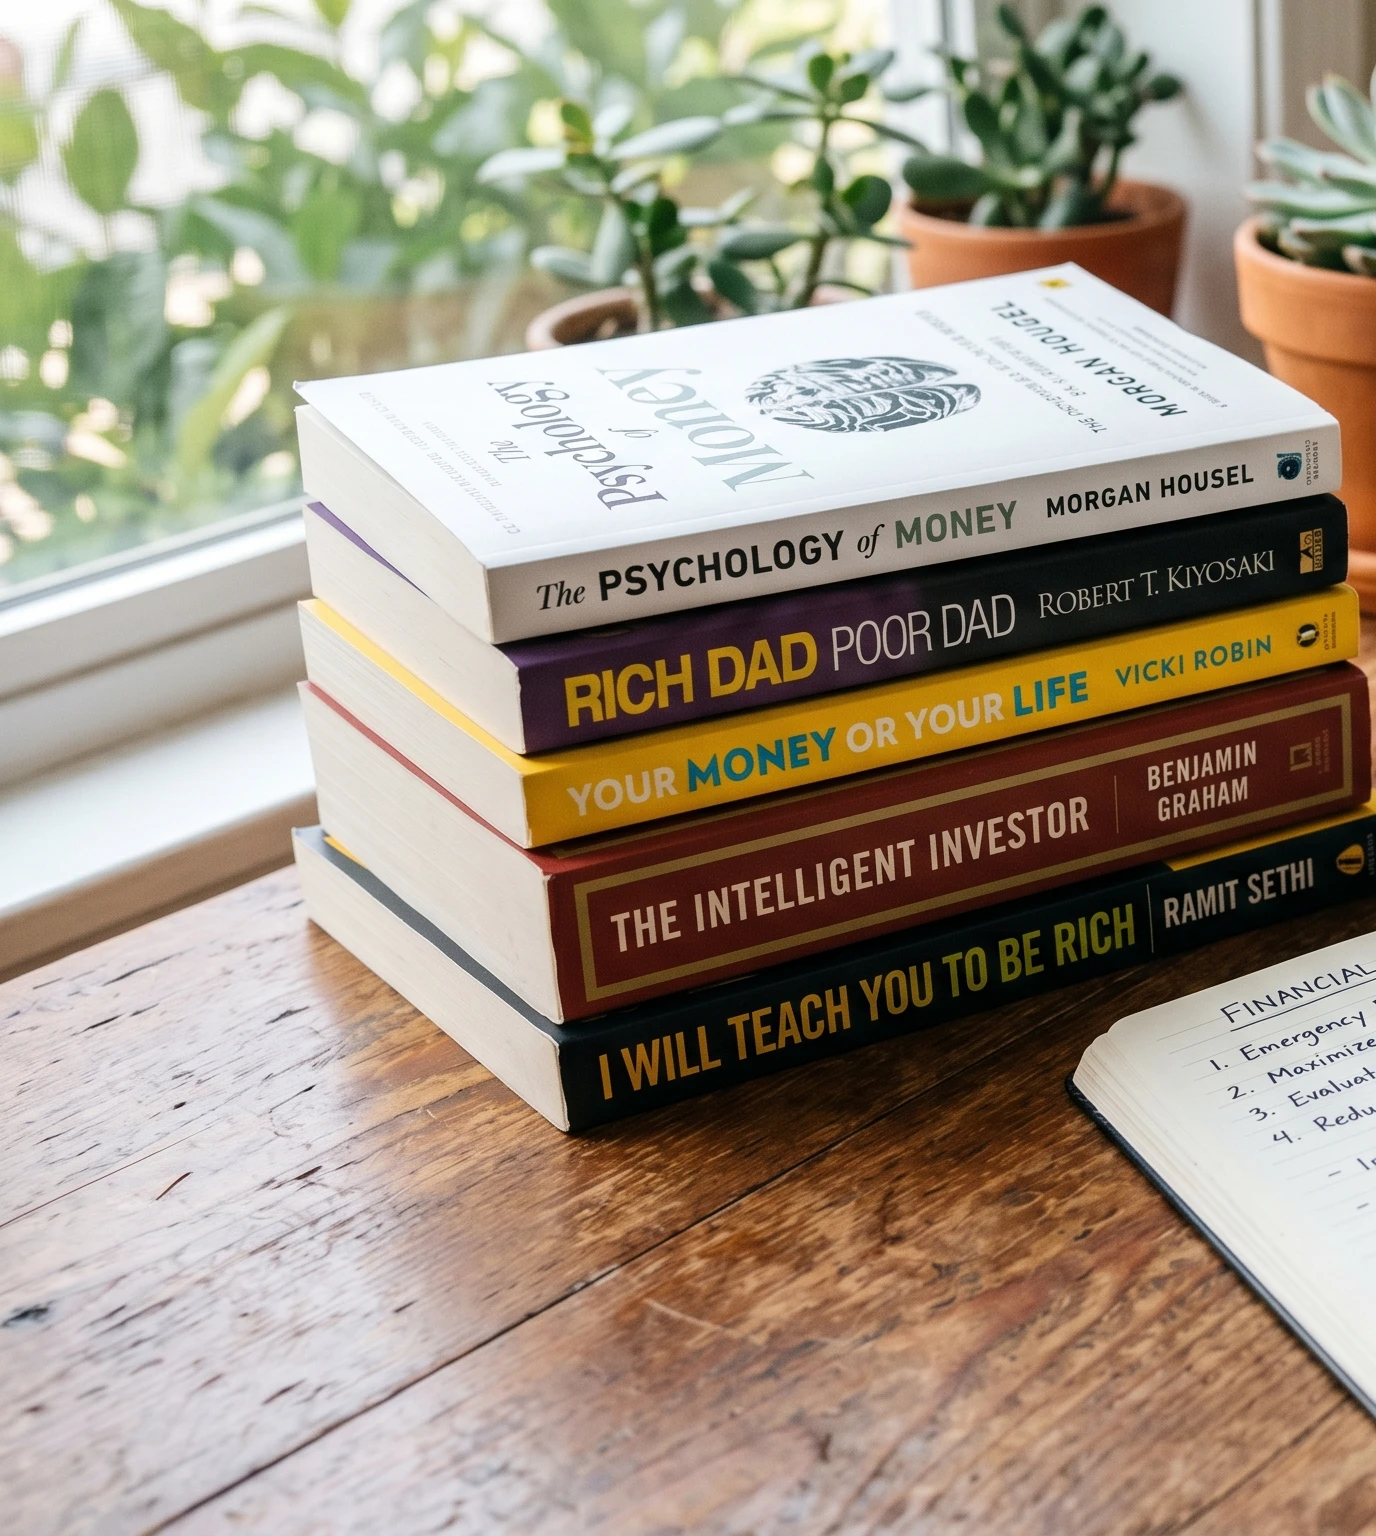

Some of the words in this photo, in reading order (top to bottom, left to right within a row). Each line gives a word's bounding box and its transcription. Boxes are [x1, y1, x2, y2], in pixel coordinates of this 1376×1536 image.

[1075, 357, 1187, 418] MORGAN
[487, 380, 668, 511] Psychology
[491, 441, 531, 464] The
[595, 367, 814, 492] Money
[608, 427, 652, 440] of
[1046, 480, 1151, 518] MORGAN
[1160, 463, 1254, 498] HOUSEL
[537, 581, 585, 611] The
[598, 530, 844, 601] PSYCHOLOGY
[857, 523, 885, 558] of
[894, 500, 1018, 549] MONEY
[1038, 578, 1135, 619] ROBERT
[1140, 570, 1160, 597] T.
[1167, 549, 1276, 590] KIYOSAKI
[564, 653, 695, 728] RICH
[707, 630, 819, 699] DAD
[831, 608, 933, 672] POOR
[942, 593, 1017, 649] DAD
[1116, 654, 1186, 688] VICKI
[1194, 634, 1273, 671] ROBIN
[567, 766, 679, 817] YOUR
[687, 727, 837, 792] MONEY
[845, 716, 899, 754] OR
[904, 693, 1005, 740] YOUR
[1012, 670, 1089, 718] LIFE
[1147, 740, 1258, 791] BENJAMIN
[1157, 775, 1250, 822] GRAHAM
[610, 900, 682, 953] THE
[694, 839, 916, 932] INTELLIGENT
[929, 796, 1089, 871] INVESTOR
[1163, 879, 1240, 929] RAMIT
[1247, 857, 1315, 905] SETHI
[599, 1054, 613, 1101] I
[621, 1025, 722, 1092] WILL
[728, 984, 852, 1062] TEACH
[859, 962, 934, 1022] YOU
[942, 946, 988, 998] TO
[998, 929, 1045, 984] BE
[1053, 903, 1136, 967] RICH
[1209, 1058, 1229, 1071] 1.
[1239, 1010, 1367, 1061] Emergency
[1227, 1085, 1254, 1100] 2.
[1249, 1107, 1276, 1121] 3.
[1273, 1130, 1302, 1144] 4.
